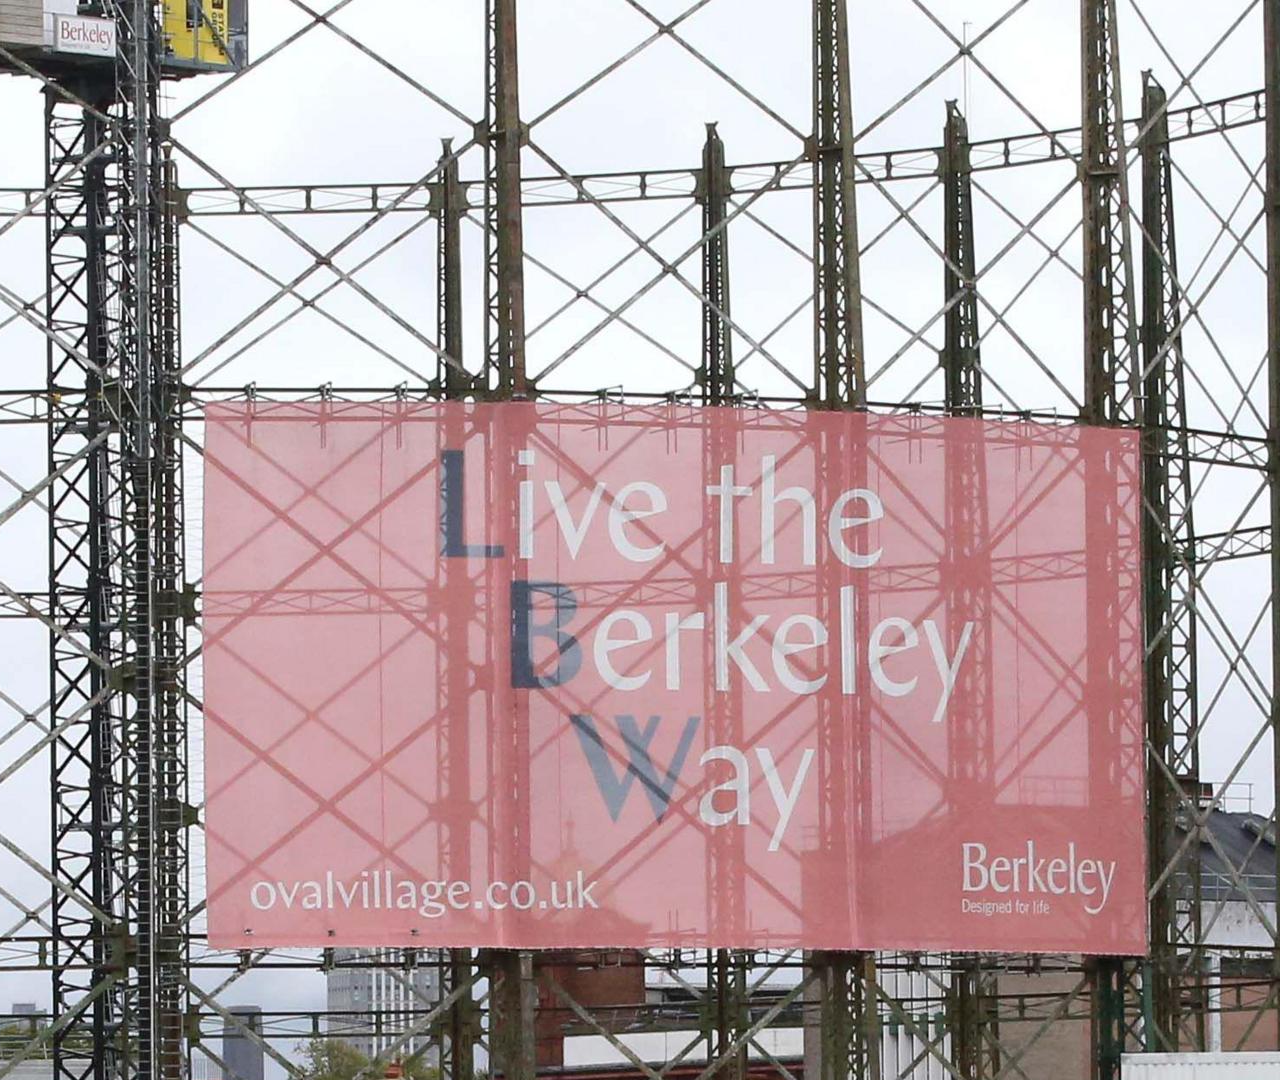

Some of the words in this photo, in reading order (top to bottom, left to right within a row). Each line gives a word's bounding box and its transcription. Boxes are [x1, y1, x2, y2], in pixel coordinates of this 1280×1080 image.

[61, 20, 113, 51] Berkeley
[438, 446, 669, 562] Live
[706, 454, 885, 570] the
[508, 579, 975, 724] Berkeley
[569, 712, 816, 852] Way
[249, 870, 600, 918] ovalvillage.co.uk
[960, 840, 1117, 915] Berkeley
[961, 898, 1012, 916] Designed
[1015, 899, 1030, 914] for
[1032, 899, 1051, 914] life
